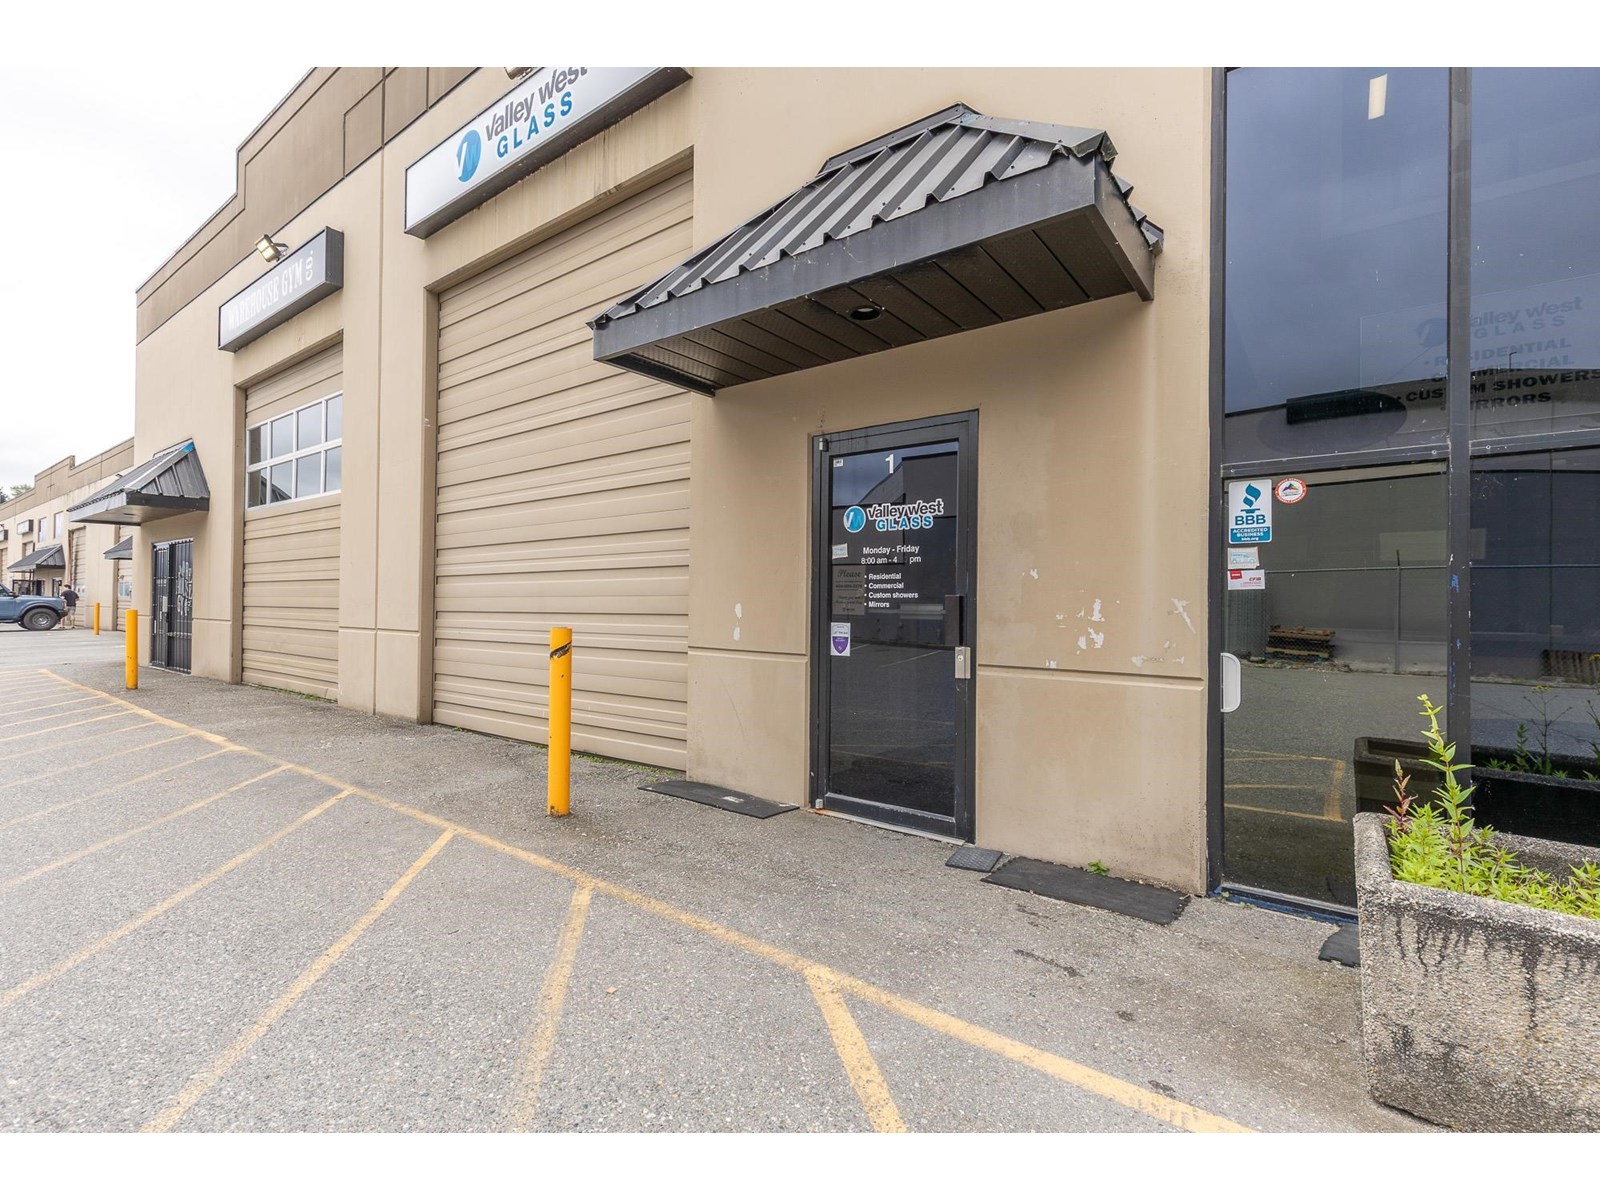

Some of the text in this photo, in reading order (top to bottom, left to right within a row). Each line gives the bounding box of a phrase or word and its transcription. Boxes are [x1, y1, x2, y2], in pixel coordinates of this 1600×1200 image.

[485, 92, 535, 141] Valley
[497, 91, 573, 158] GLASS
[281, 258, 303, 297] GYM
[1470, 310, 1520, 328] alley
[1473, 315, 1566, 339] GLASS
[1434, 338, 1572, 367] RIDENTIAL
[1405, 369, 1600, 402] CUSM SHOWERS
[1470, 391, 1552, 411] IRRORS
[885, 453, 895, 474] 1
[867, 504, 906, 520] Valley
[1234, 514, 1267, 526] BBB
[876, 514, 934, 531] GLASS
[862, 546, 891, 555] Monday
[896, 544, 920, 554] Friday
[860, 556, 876, 565] 8:00
[909, 556, 922, 564] pm
[837, 568, 862, 578] Please
[868, 591, 892, 599] Custom
